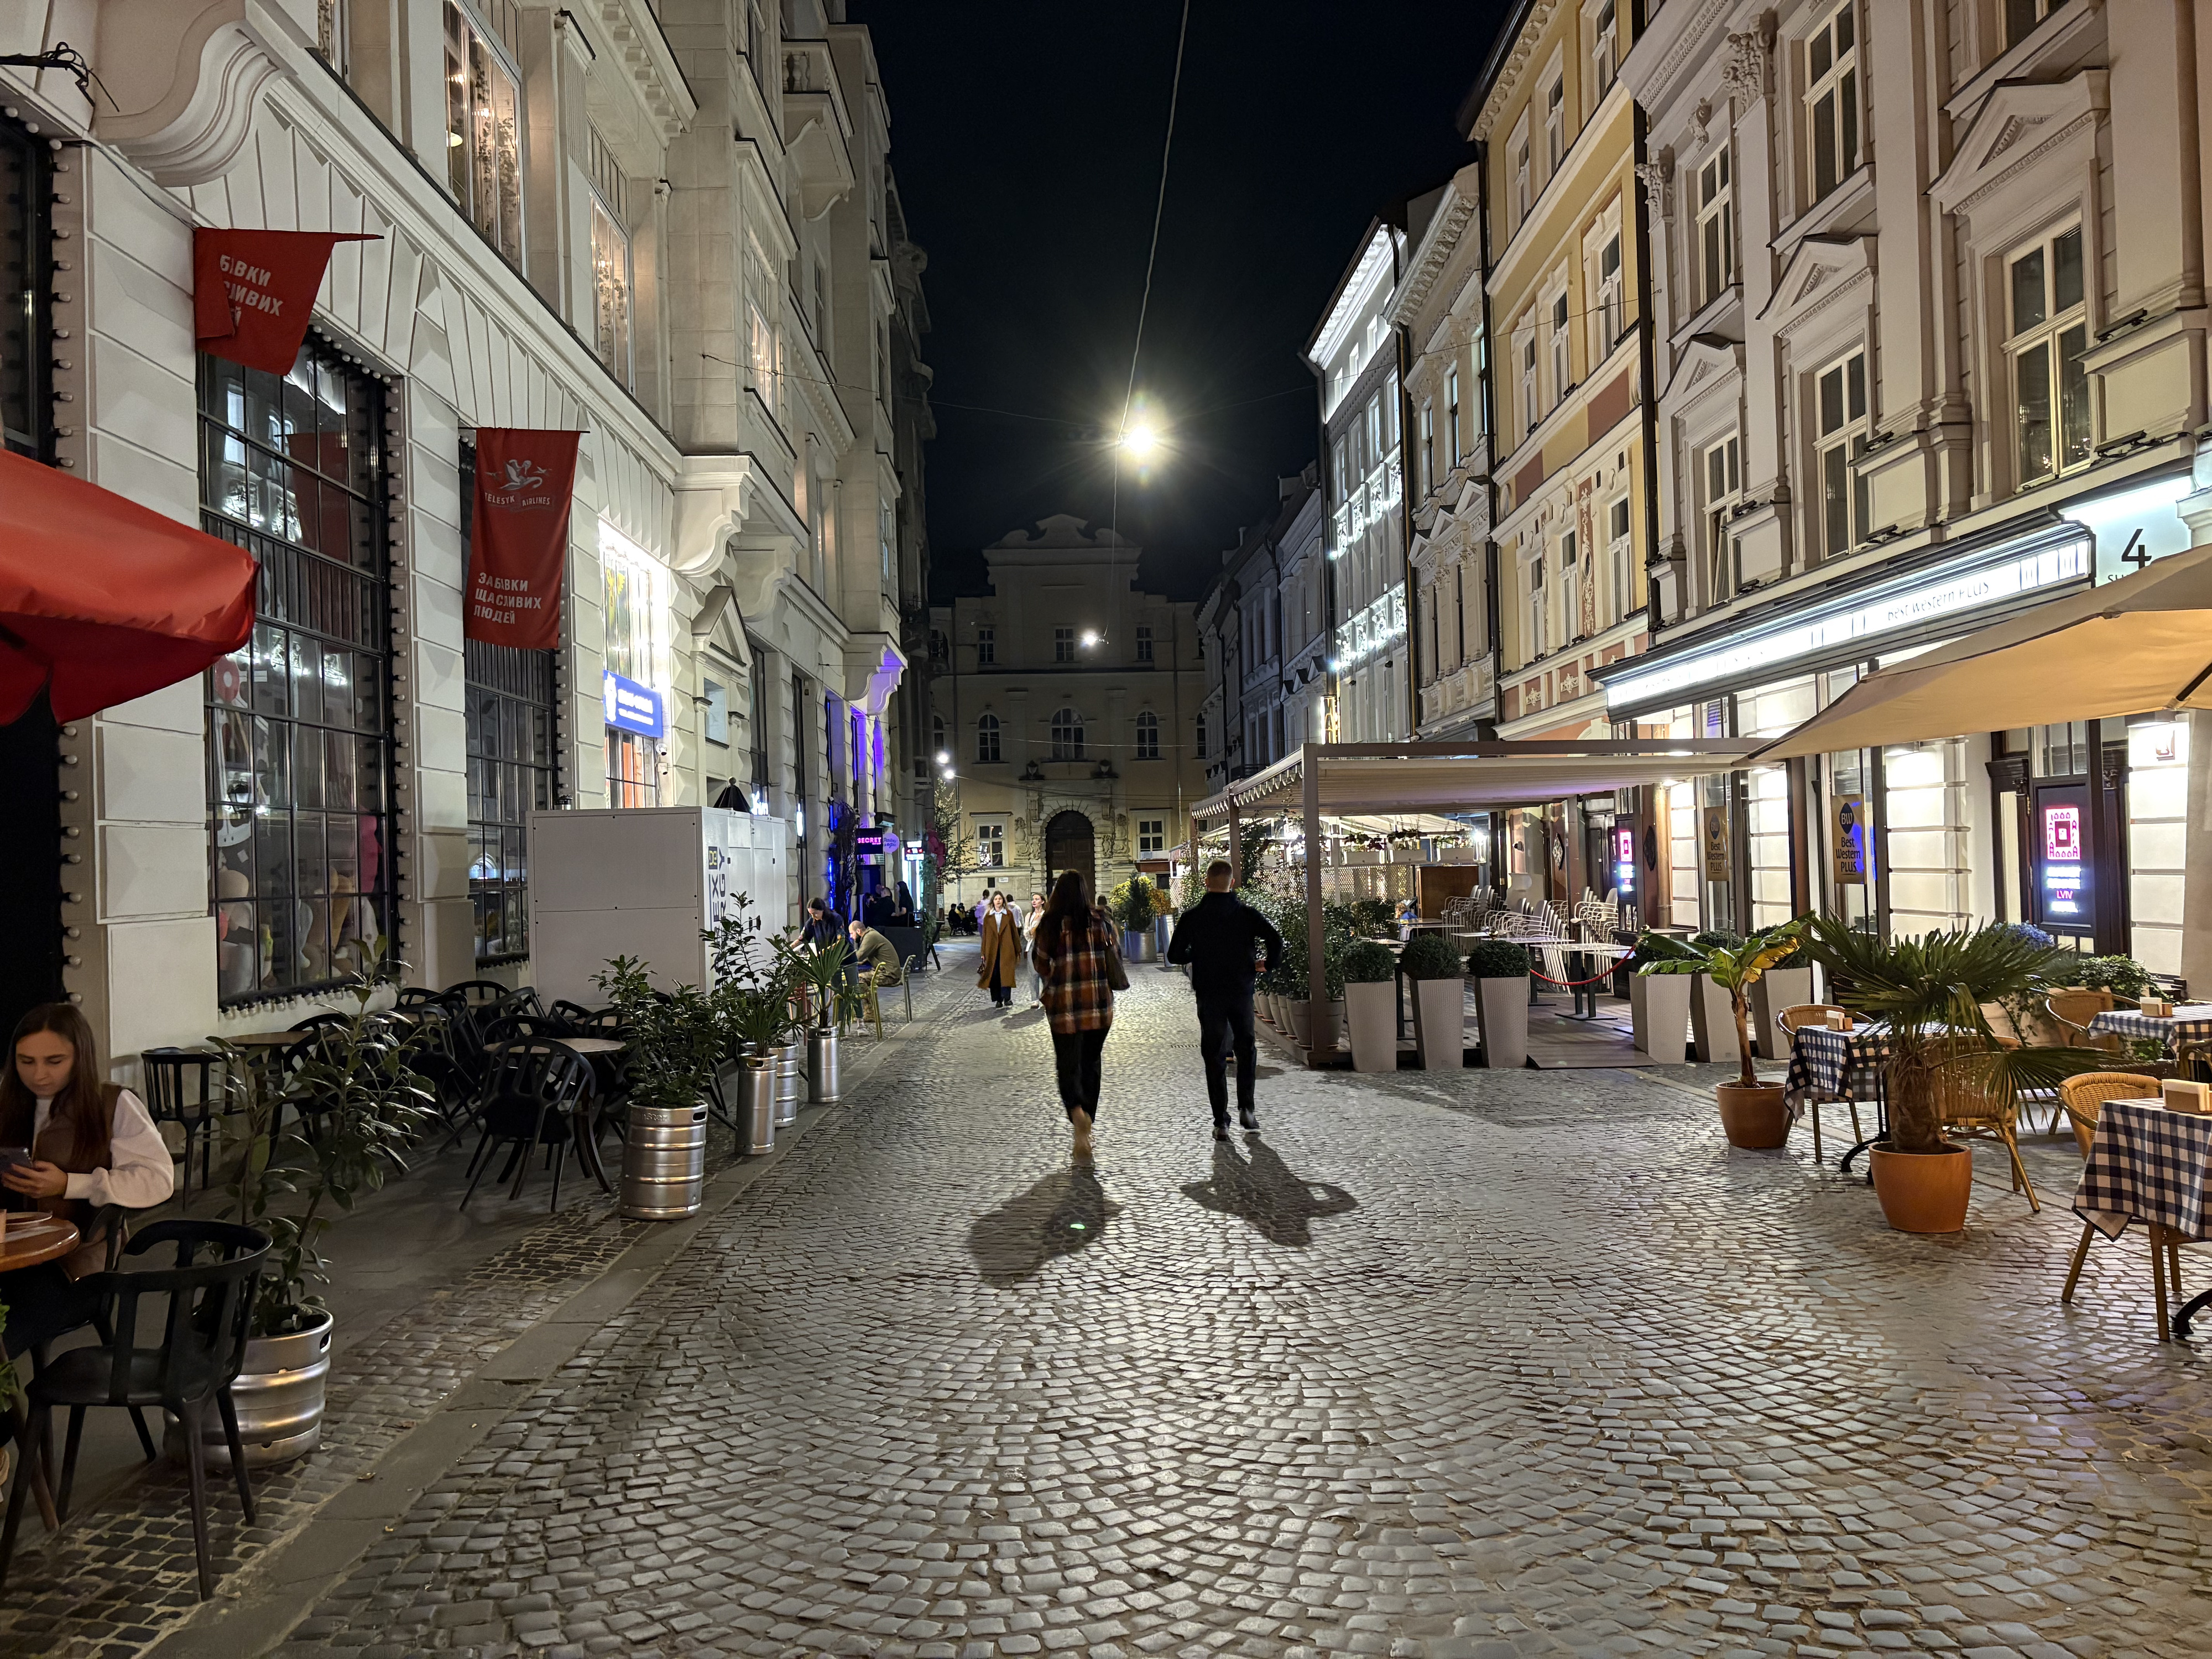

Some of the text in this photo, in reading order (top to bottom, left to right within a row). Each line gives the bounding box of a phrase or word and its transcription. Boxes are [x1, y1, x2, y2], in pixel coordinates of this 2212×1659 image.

[485, 492, 550, 507] TELESYK AIRLINES
[2121, 529, 2152, 570] 4
[475, 588, 542, 609] ЩАСЛИВИХ
[474, 604, 515, 625] ЛЮДЕЙ
[1841, 813, 1853, 825] BW
[1710, 842, 1720, 851] Best
[1841, 837, 1855, 848] Best
[1707, 852, 1725, 860] Western
[1836, 848, 1861, 859] Western
[1710, 862, 1722, 872] PLUS
[1841, 862, 1857, 873] PLUS
[2057, 890, 2073, 900] LVIV
